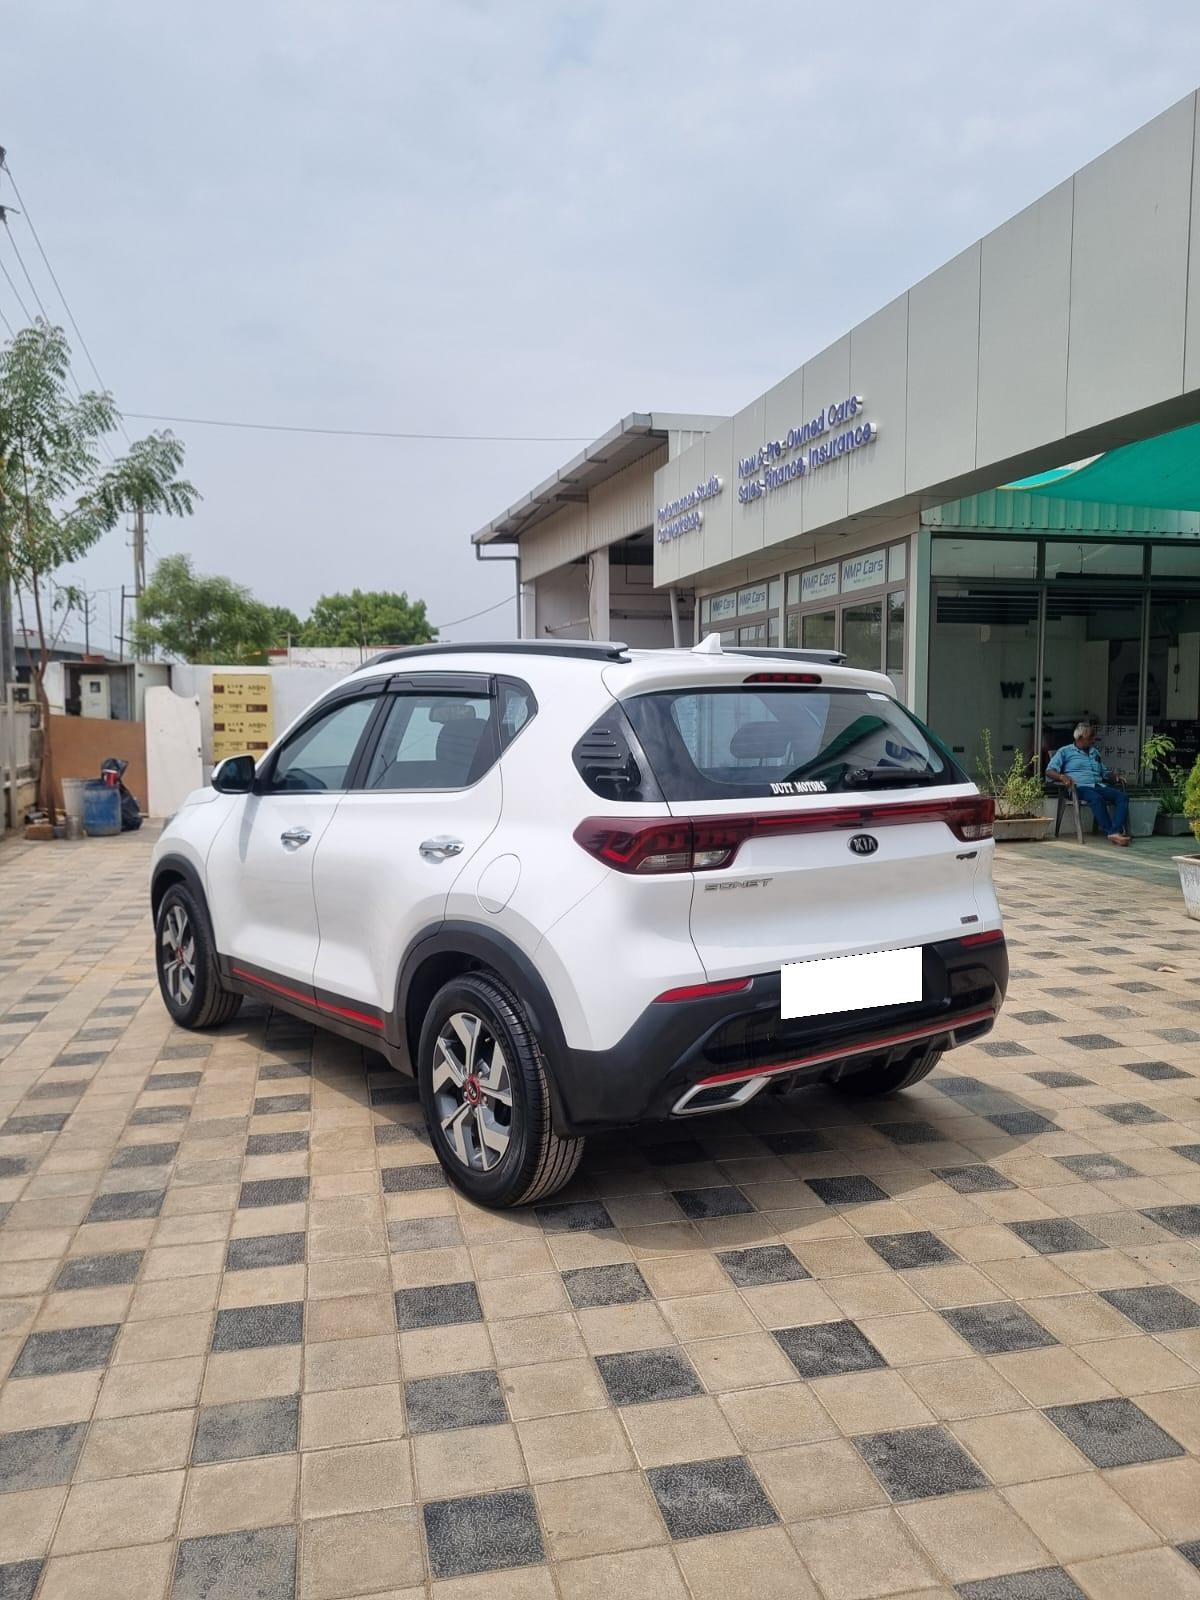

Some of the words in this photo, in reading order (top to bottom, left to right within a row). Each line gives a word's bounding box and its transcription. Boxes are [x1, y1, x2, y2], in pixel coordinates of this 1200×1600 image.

[738, 456, 757, 479] New
[827, 396, 859, 427] Cars
[808, 422, 873, 469] Insurance
[696, 475, 721, 502] Studio
[843, 562, 862, 580] NMP
[863, 559, 884, 575] Cars
[803, 574, 819, 592] NMP
[819, 572, 836, 587] Cars
[723, 598, 735, 610] Cars
[751, 591, 766, 603] Cars
[770, 782, 794, 794] DUTT
[794, 780, 828, 792] MOTORS
[852, 837, 877, 852] KIA
[704, 877, 774, 891] SONET
